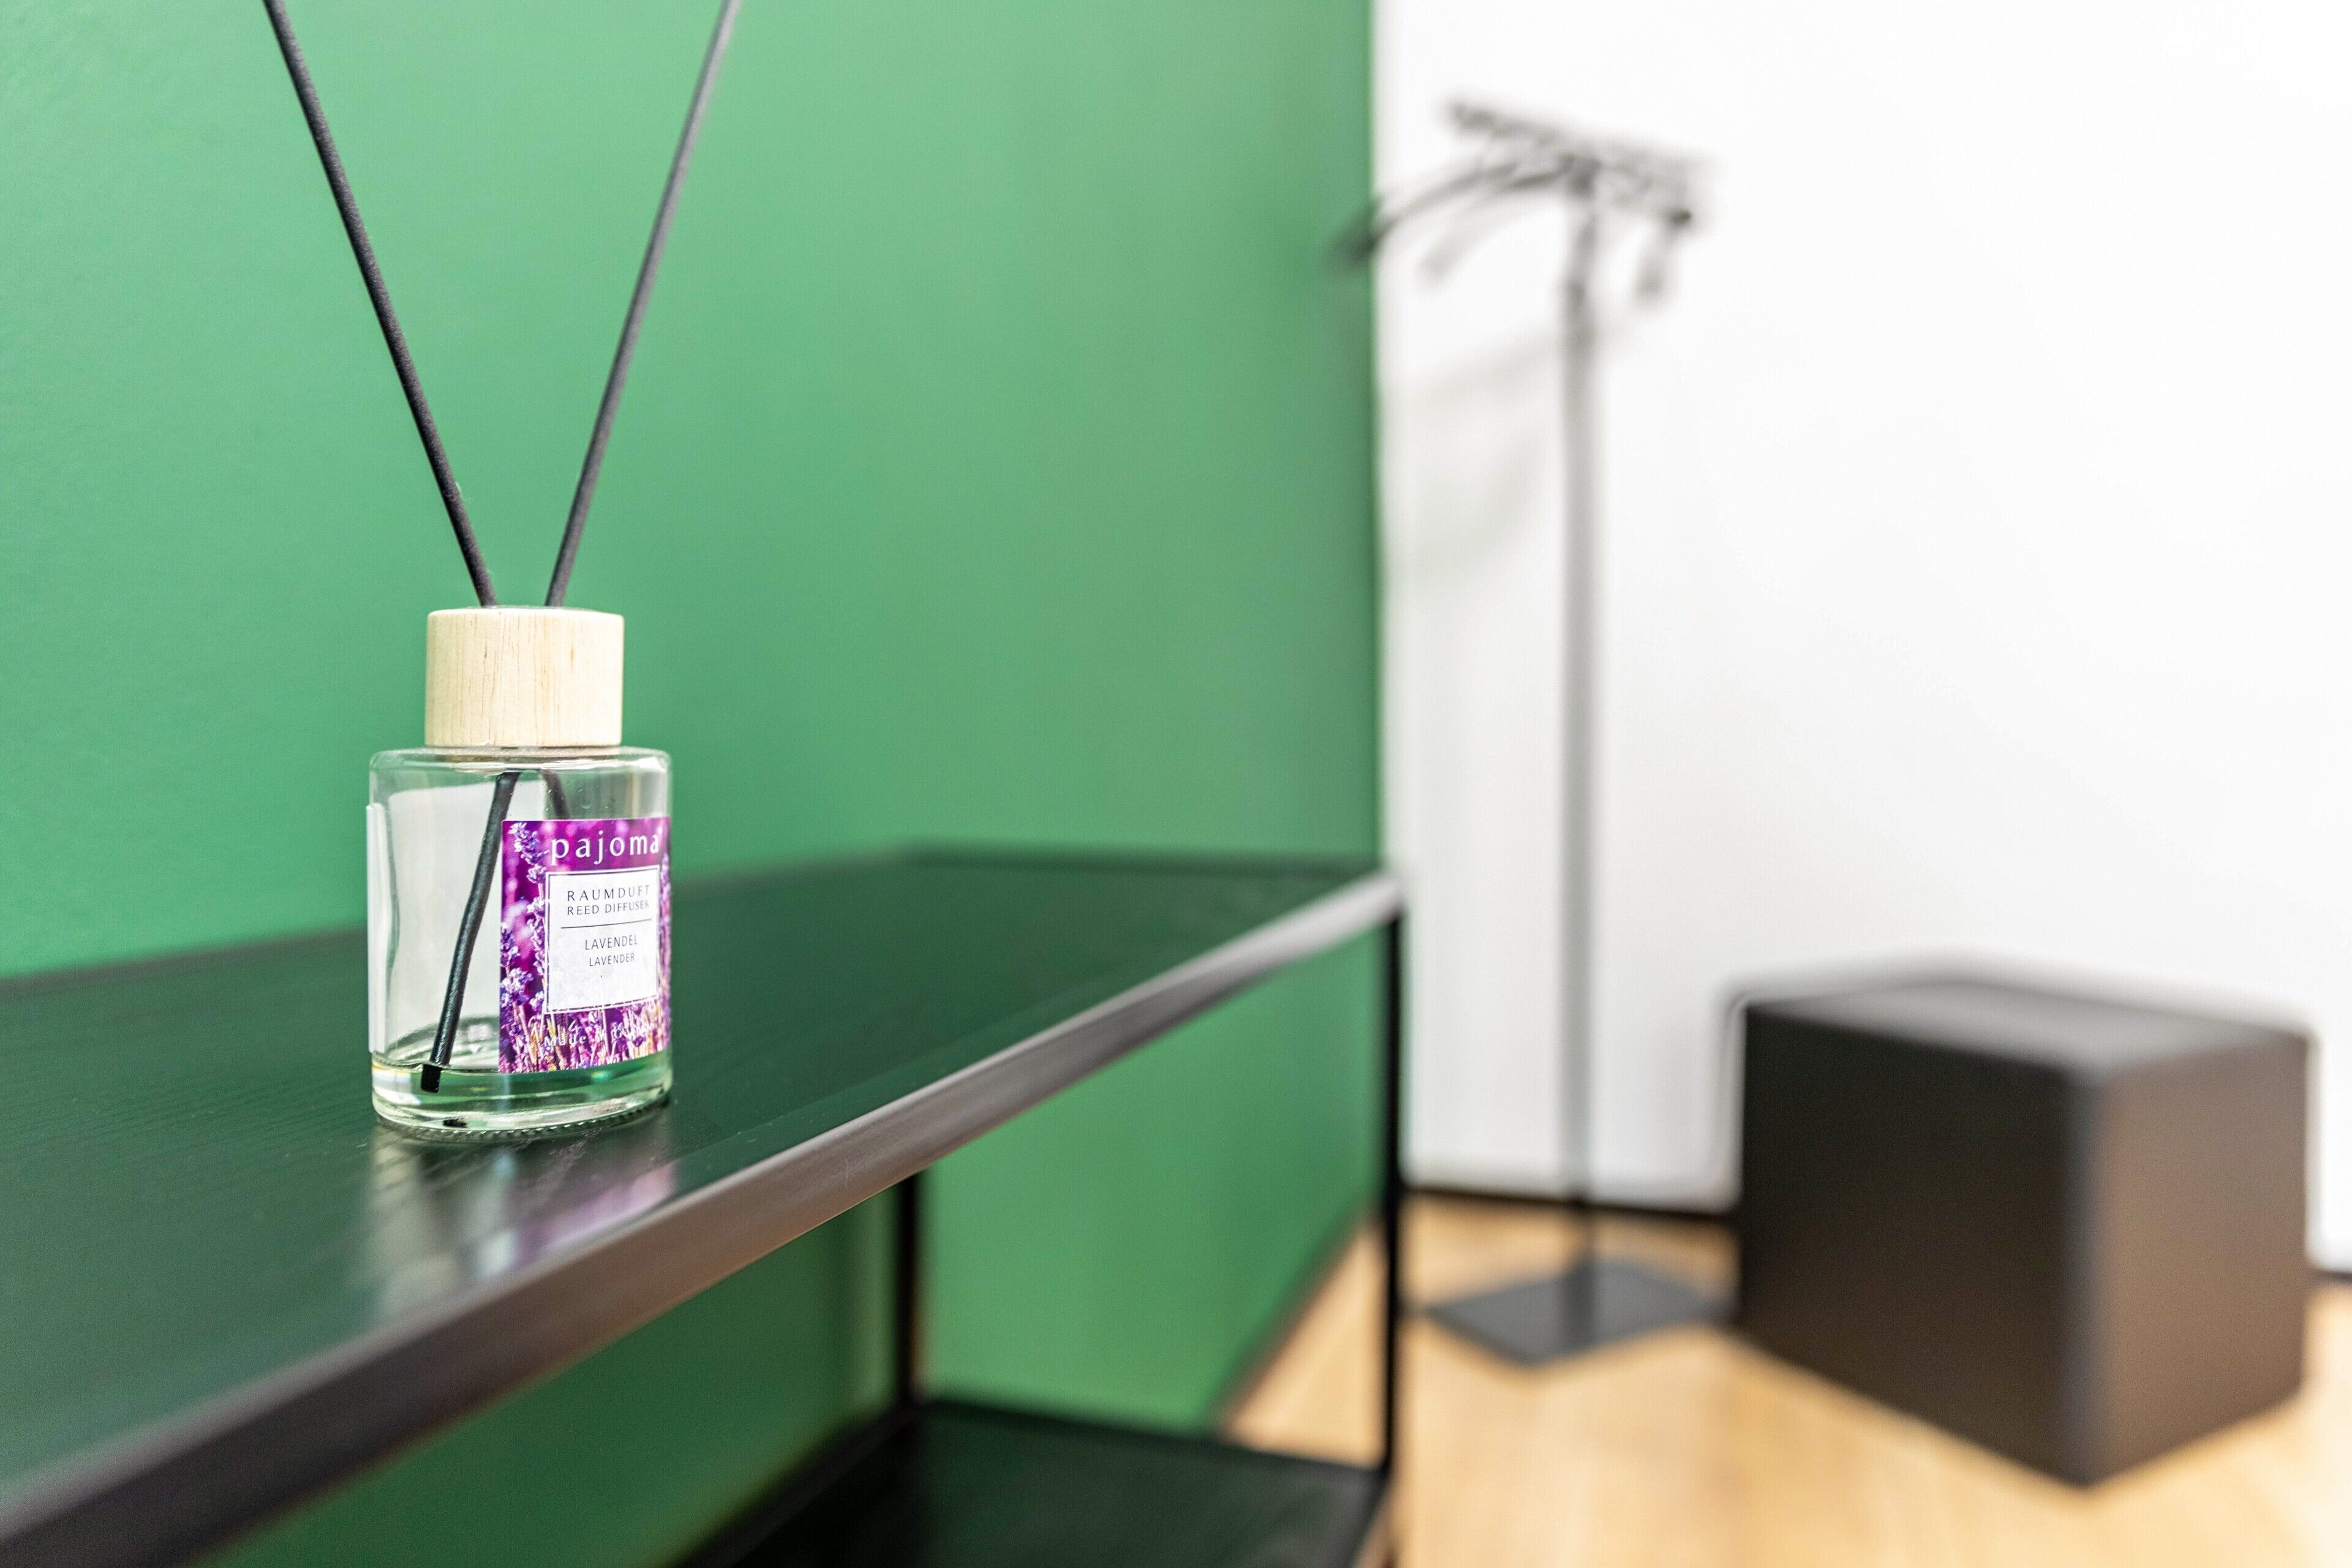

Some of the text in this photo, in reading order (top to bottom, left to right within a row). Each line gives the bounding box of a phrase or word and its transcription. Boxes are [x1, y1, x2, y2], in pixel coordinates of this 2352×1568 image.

[551, 830, 659, 865] pajoma
[567, 885, 650, 901] RAUMDUFT
[567, 900, 649, 915] REED DIFFUSER
[585, 935, 638, 950] LAVENDEL
[589, 952, 635, 967] LAVENDER
[544, 1031, 586, 1046] Made
